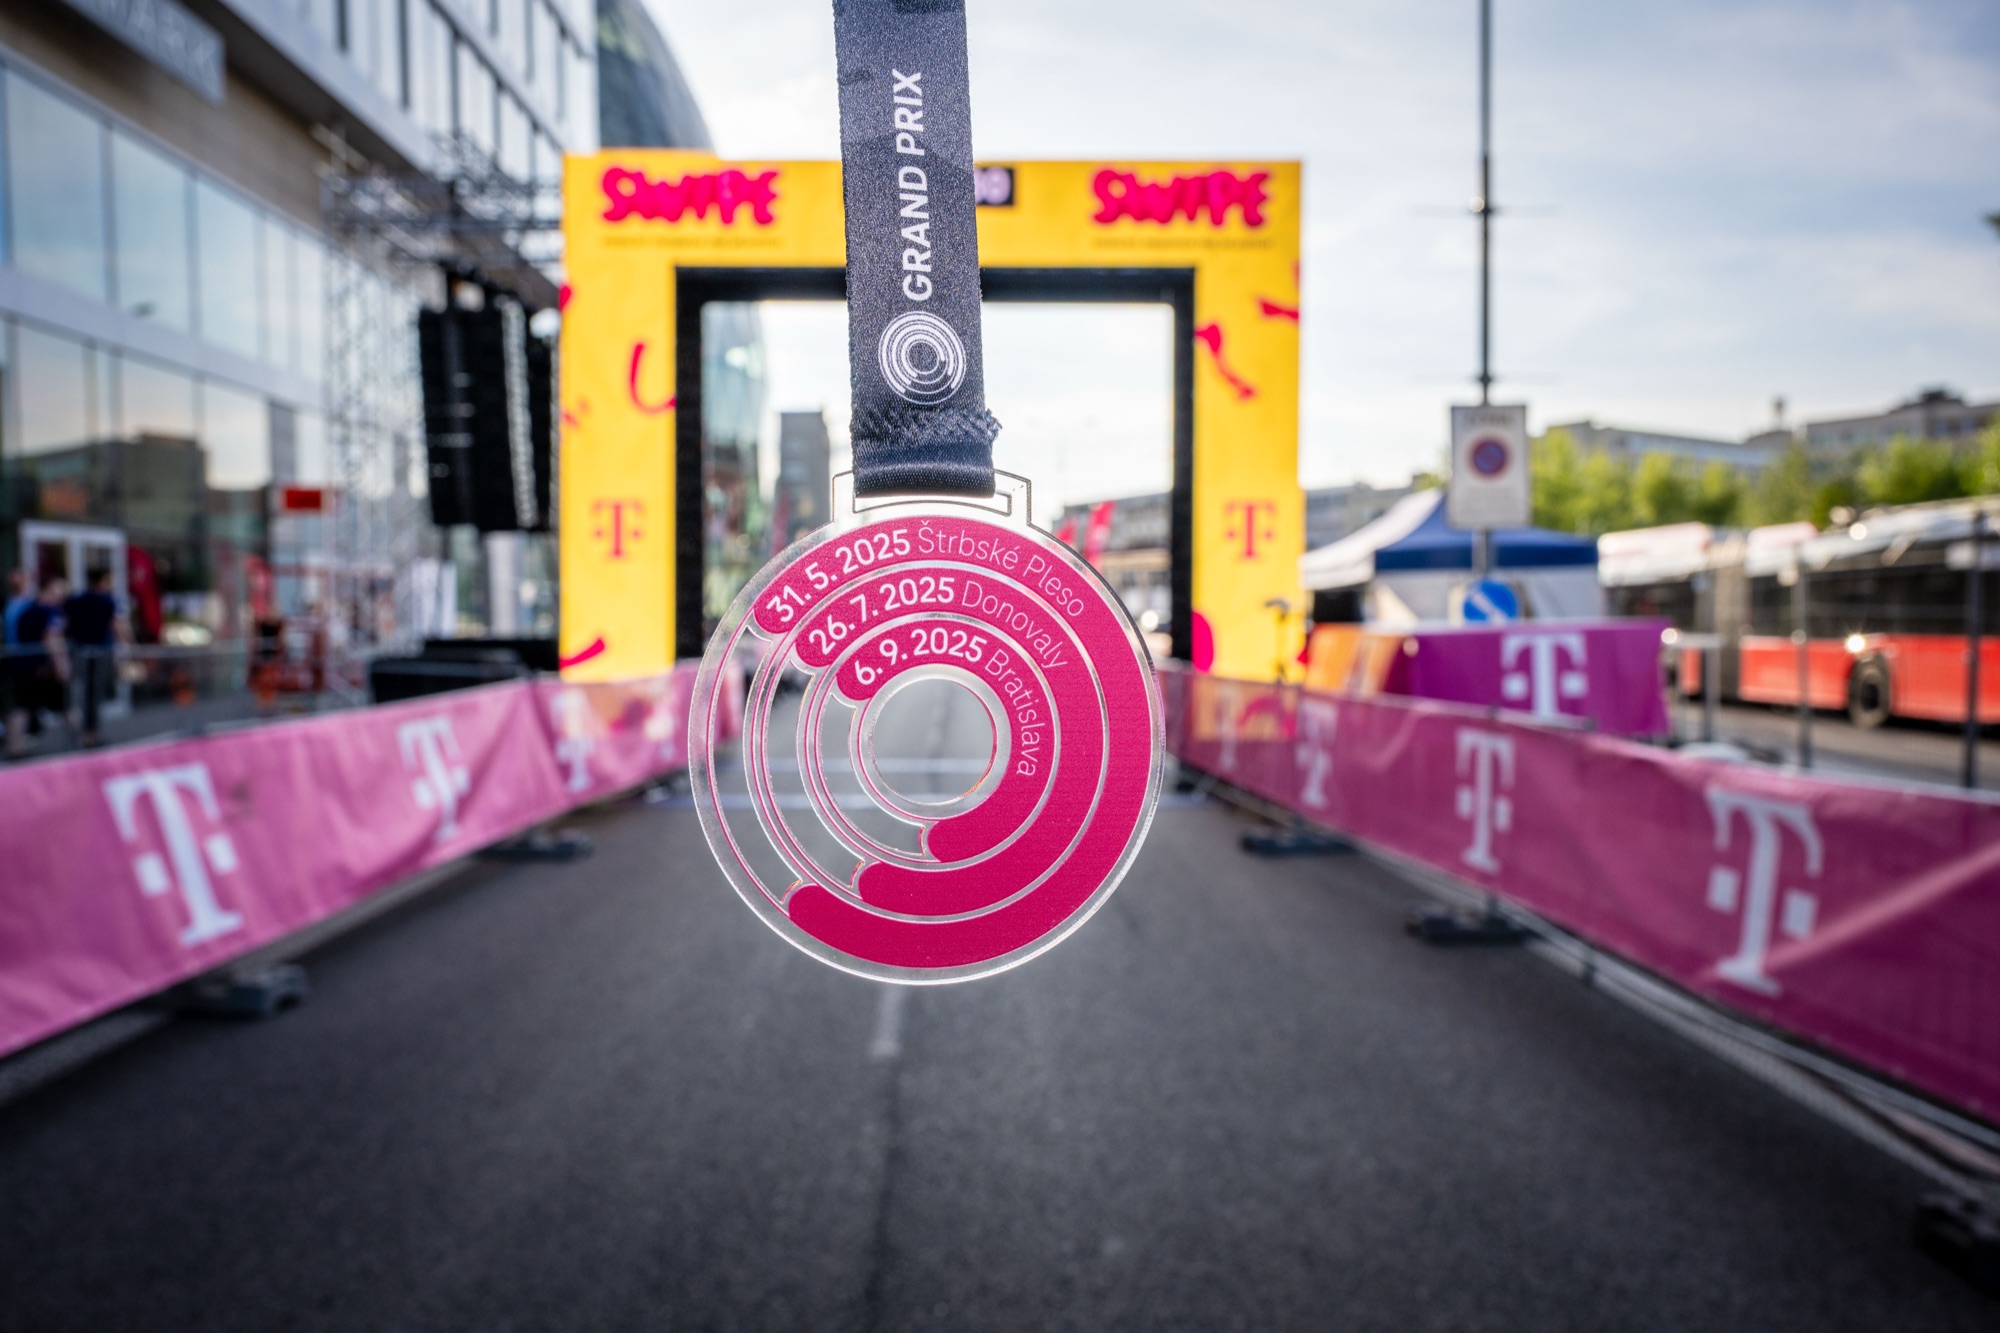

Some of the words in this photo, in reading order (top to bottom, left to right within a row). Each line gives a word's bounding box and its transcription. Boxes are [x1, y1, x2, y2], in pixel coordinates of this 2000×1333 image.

[892, 69, 925, 156] PRIX
[899, 166, 933, 301] GRAND
[917, 519, 1018, 570] Štrbské
[1022, 554, 1085, 617] Pleso
[961, 579, 1068, 669] Donovaly
[984, 648, 1046, 776] Bratislava
